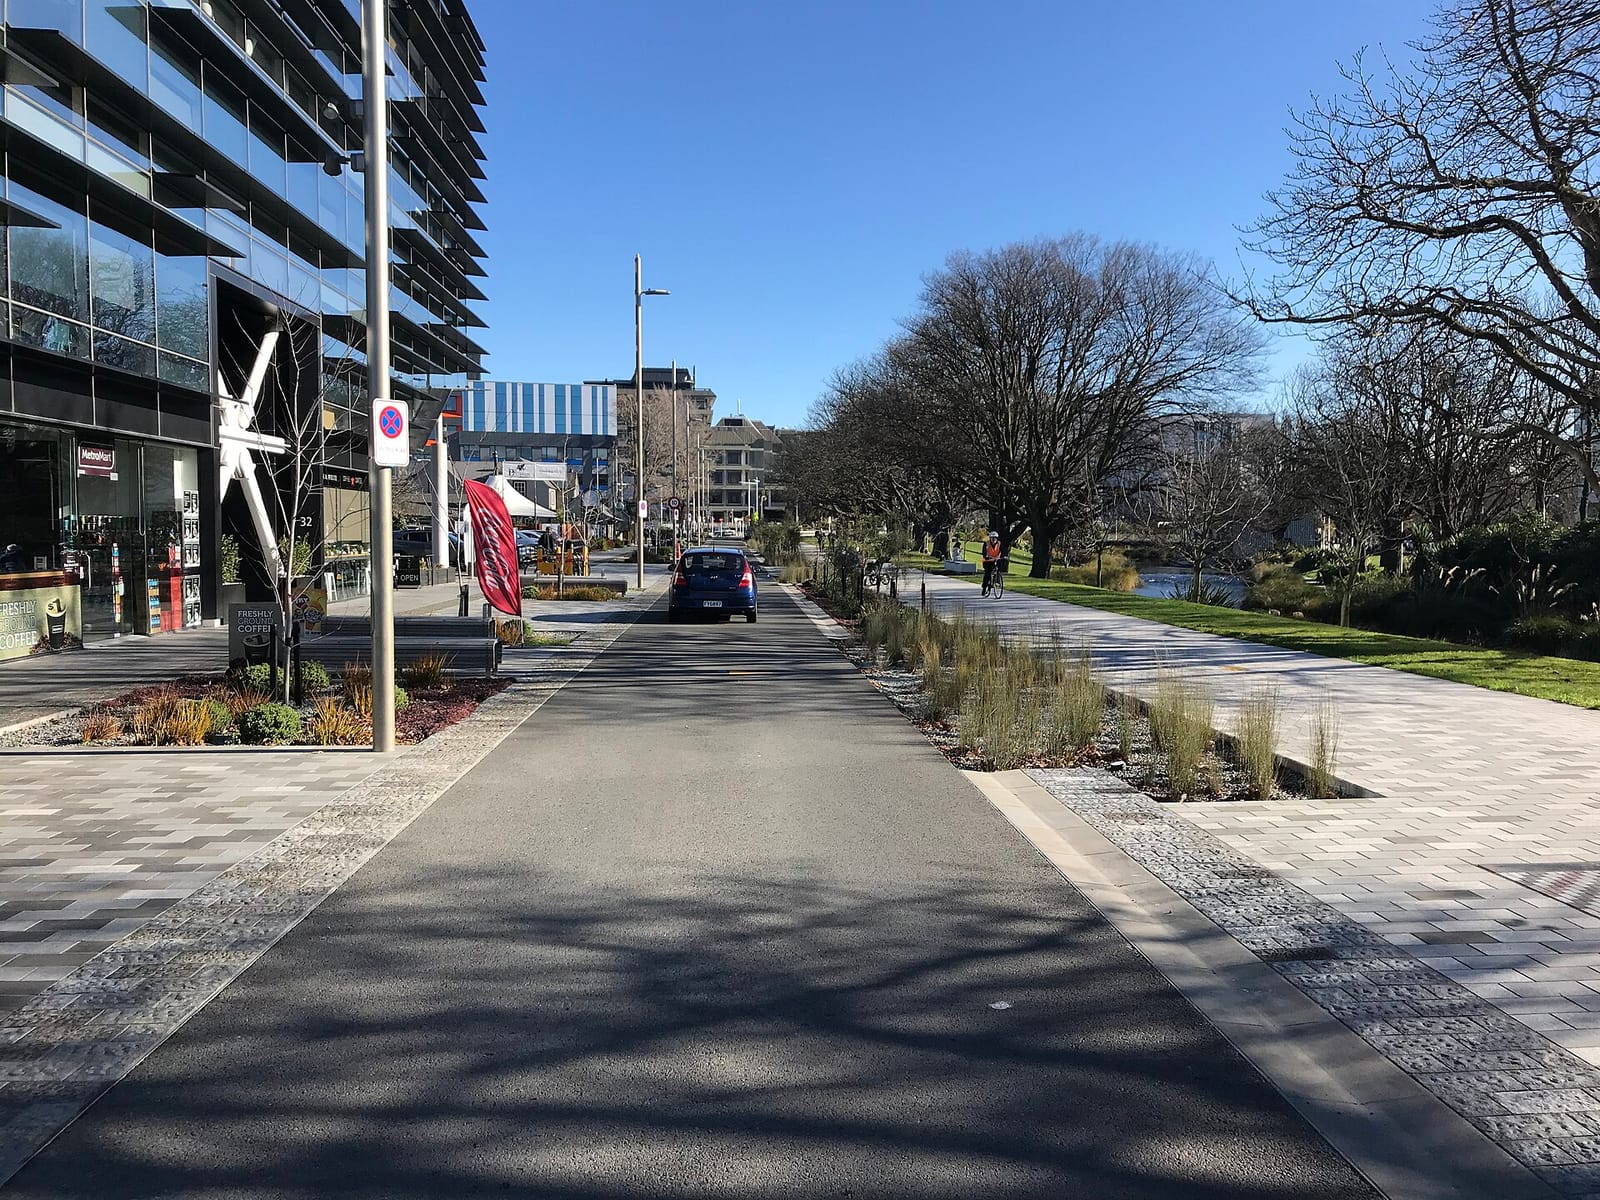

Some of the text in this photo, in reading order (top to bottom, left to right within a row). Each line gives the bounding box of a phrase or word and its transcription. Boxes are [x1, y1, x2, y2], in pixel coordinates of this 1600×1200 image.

[81, 448, 112, 462] MetroMart
[300, 517, 313, 527] 32
[400, 574, 419, 582] OPEN
[0, 630, 38, 650] COFFEE
